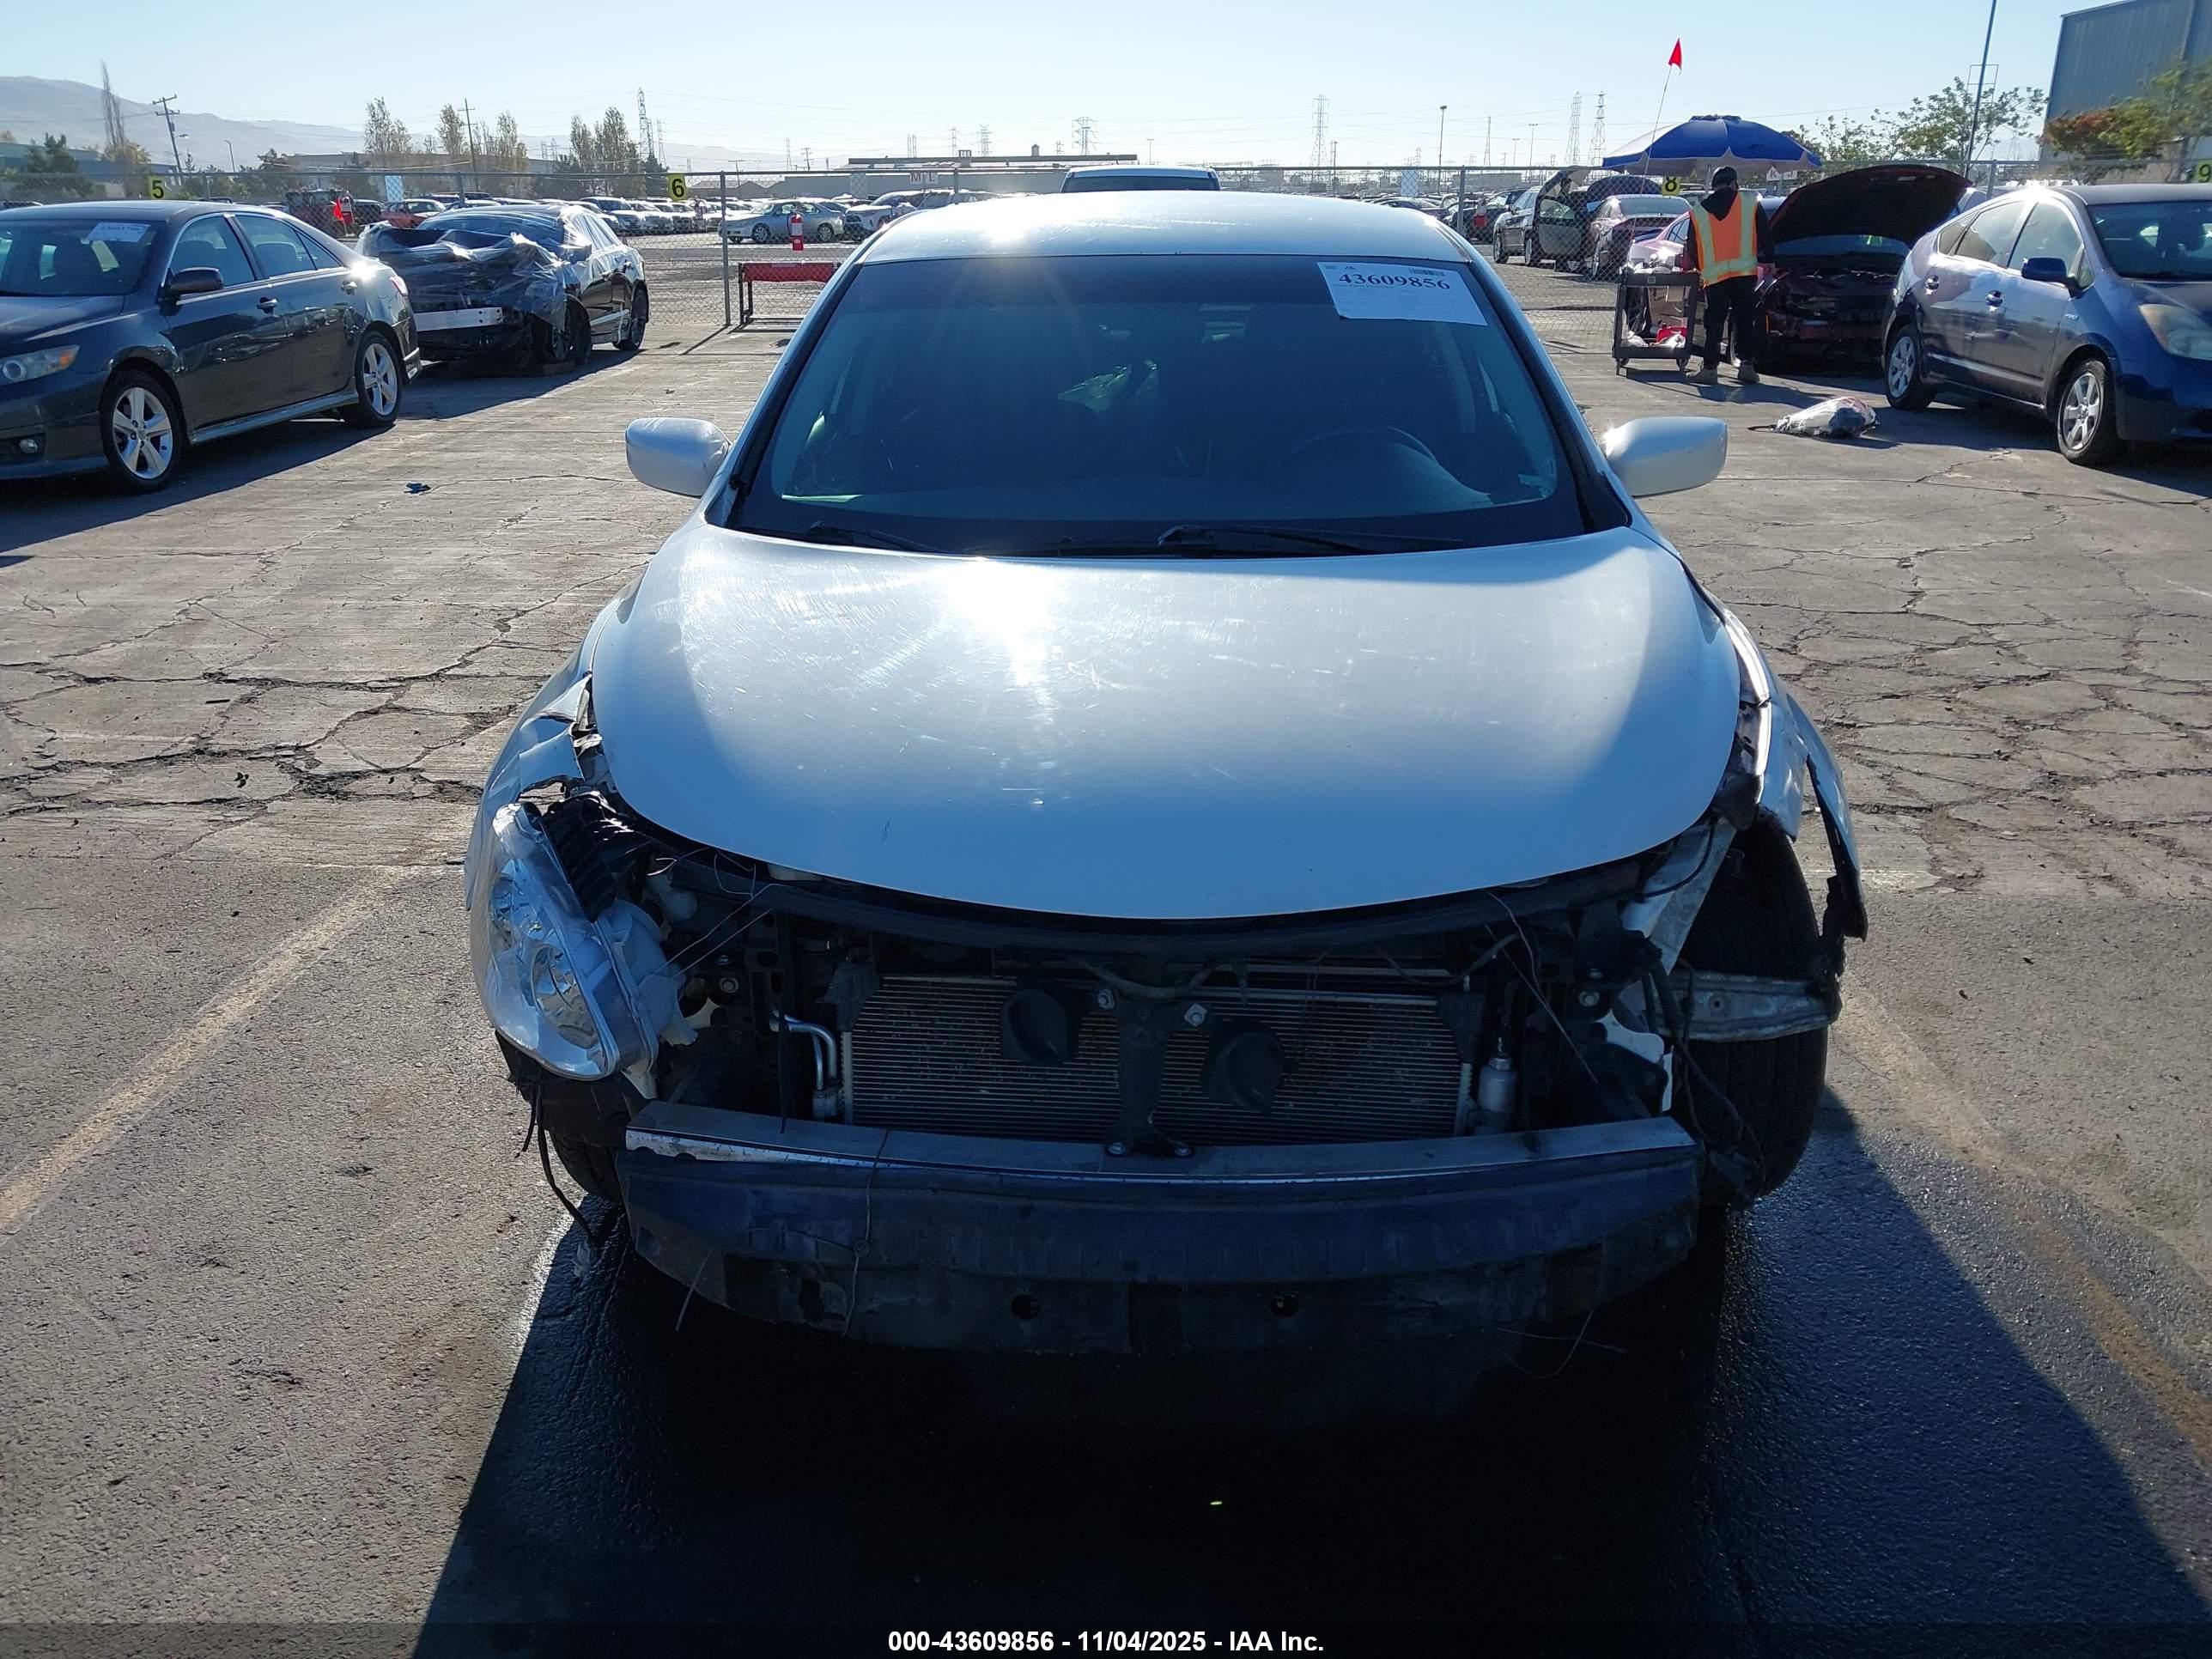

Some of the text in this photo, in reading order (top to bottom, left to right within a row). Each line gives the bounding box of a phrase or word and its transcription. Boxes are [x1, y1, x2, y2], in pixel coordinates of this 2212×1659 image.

[1665, 173, 1677, 192] 8
[2199, 164, 2211, 183] 9
[152, 179, 165, 198] 5
[672, 178, 685, 198] 6
[1339, 273, 1450, 290] 43609856
